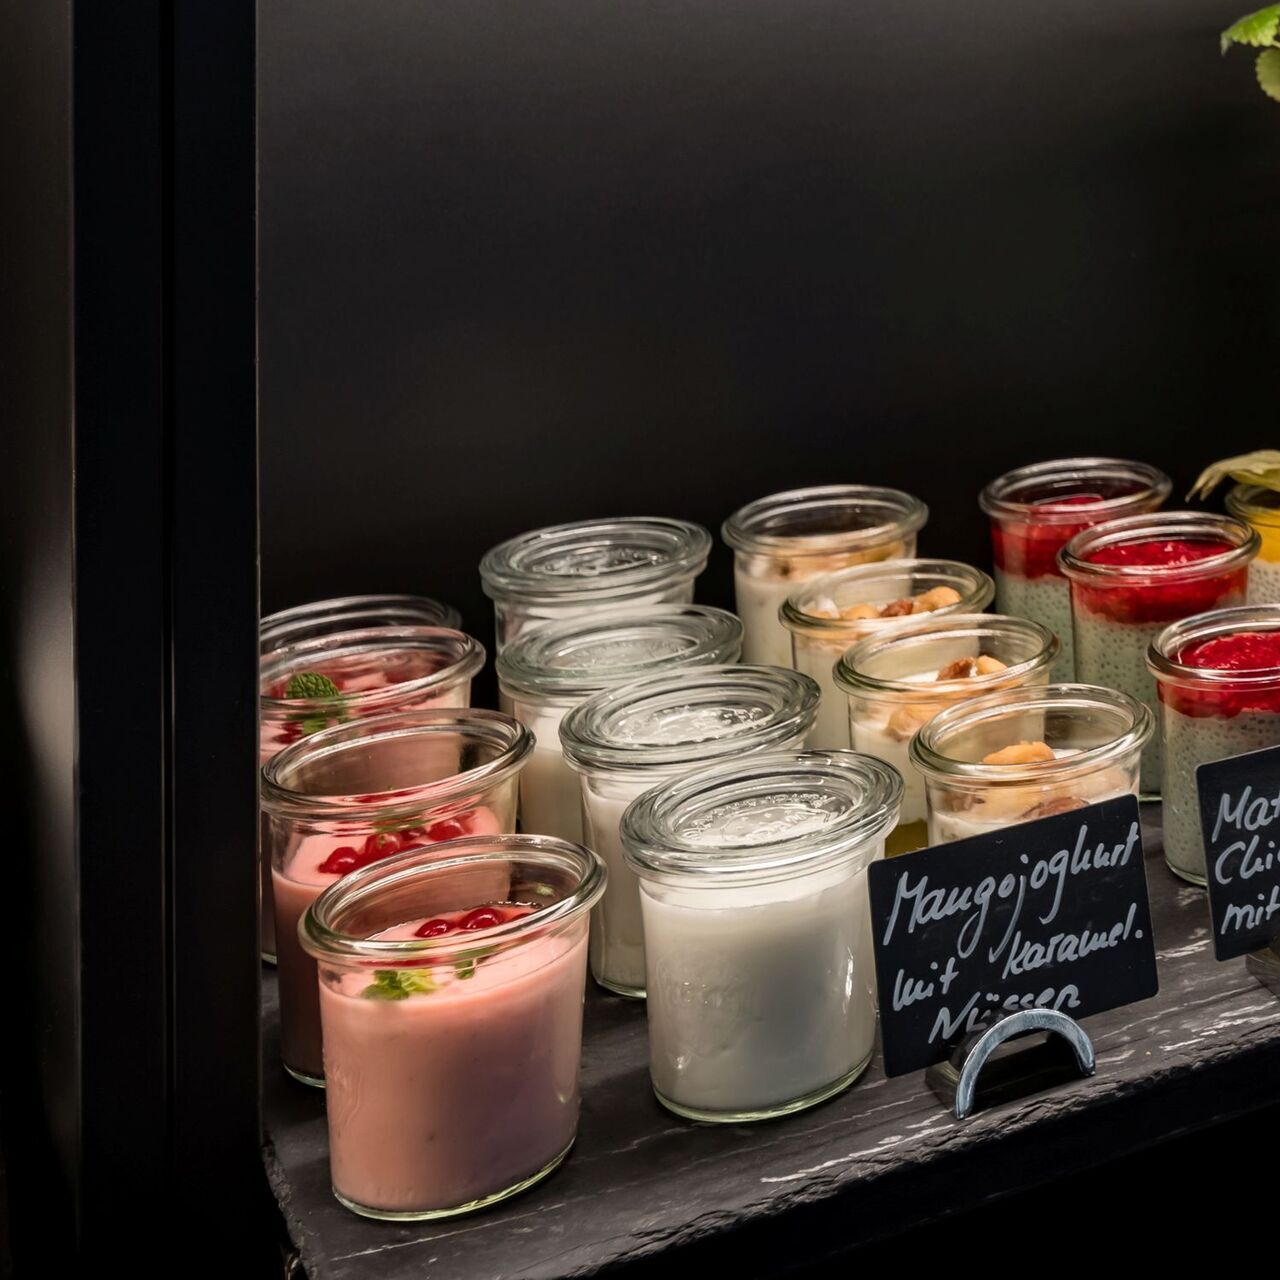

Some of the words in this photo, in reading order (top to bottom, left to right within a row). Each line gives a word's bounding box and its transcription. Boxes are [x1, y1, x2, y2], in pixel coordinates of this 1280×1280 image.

[883, 822, 1140, 963] Mangojoghurt
[1221, 885, 1280, 935] mit
[892, 957, 960, 1012] mit
